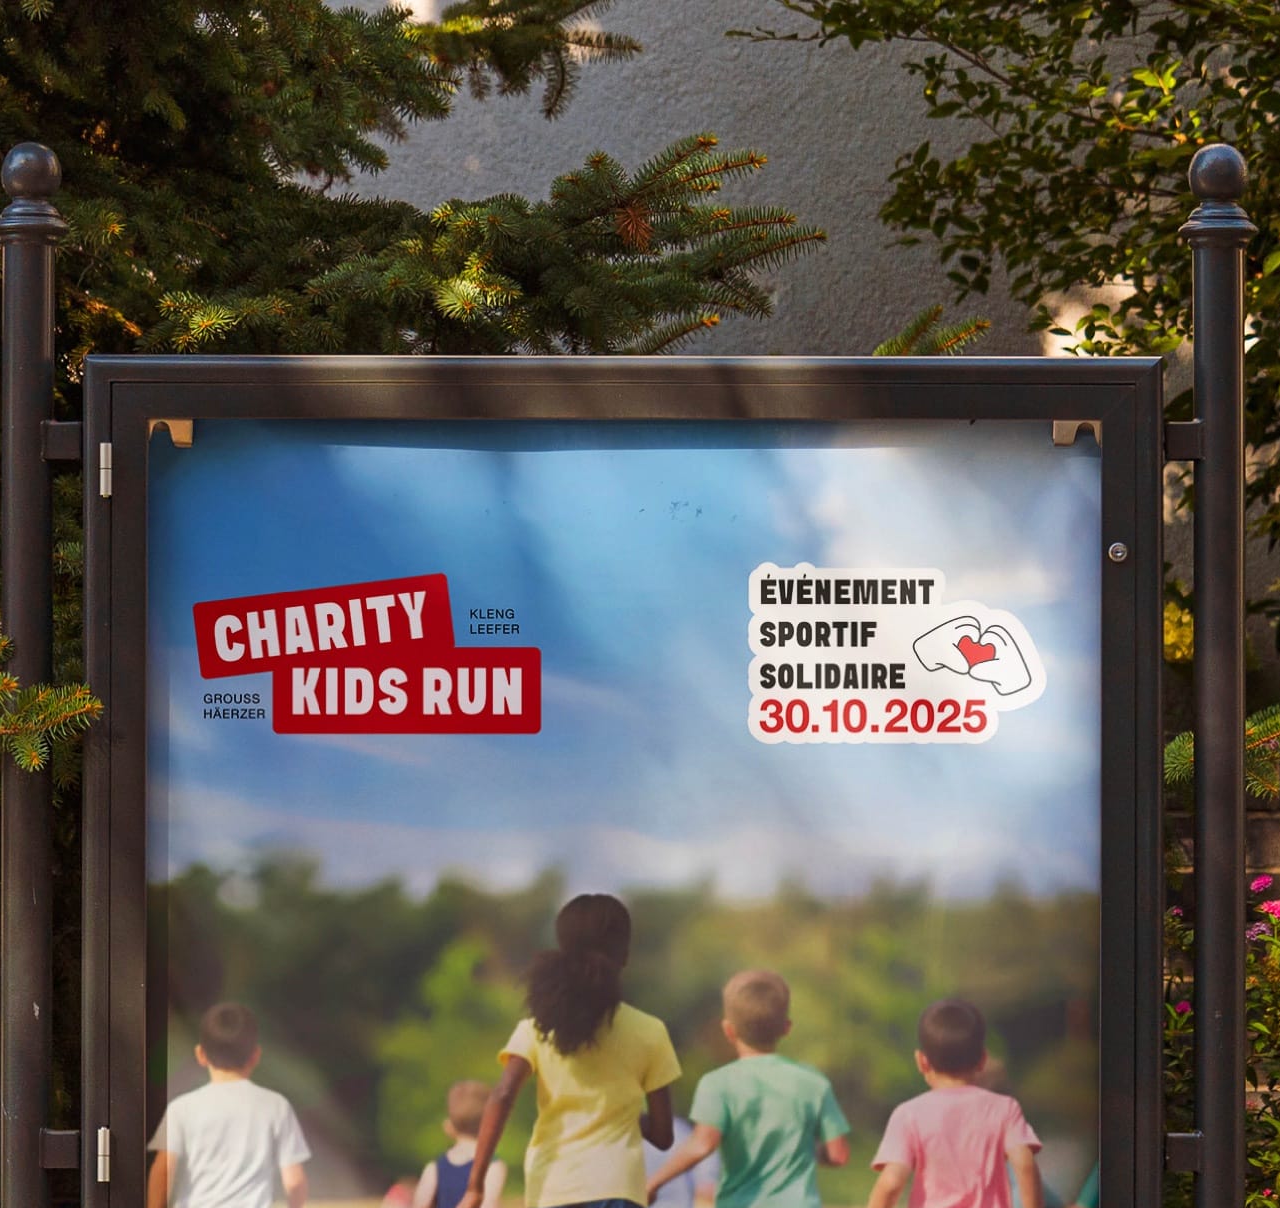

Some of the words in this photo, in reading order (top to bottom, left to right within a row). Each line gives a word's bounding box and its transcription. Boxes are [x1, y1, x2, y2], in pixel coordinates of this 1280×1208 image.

[760, 573, 934, 605] ÉVÉNEMENT
[214, 591, 426, 662] CHARITY
[469, 608, 515, 620] KLENG
[469, 623, 520, 635] LEEFER
[760, 621, 877, 647] SPORTIF
[760, 663, 906, 689] SOLIDAIRE
[203, 693, 261, 704] GROUSS
[291, 666, 409, 715] KIDS
[422, 666, 522, 715] RUN
[203, 706, 265, 719] HÄERZER
[759, 699, 988, 733] 30.10.2025
